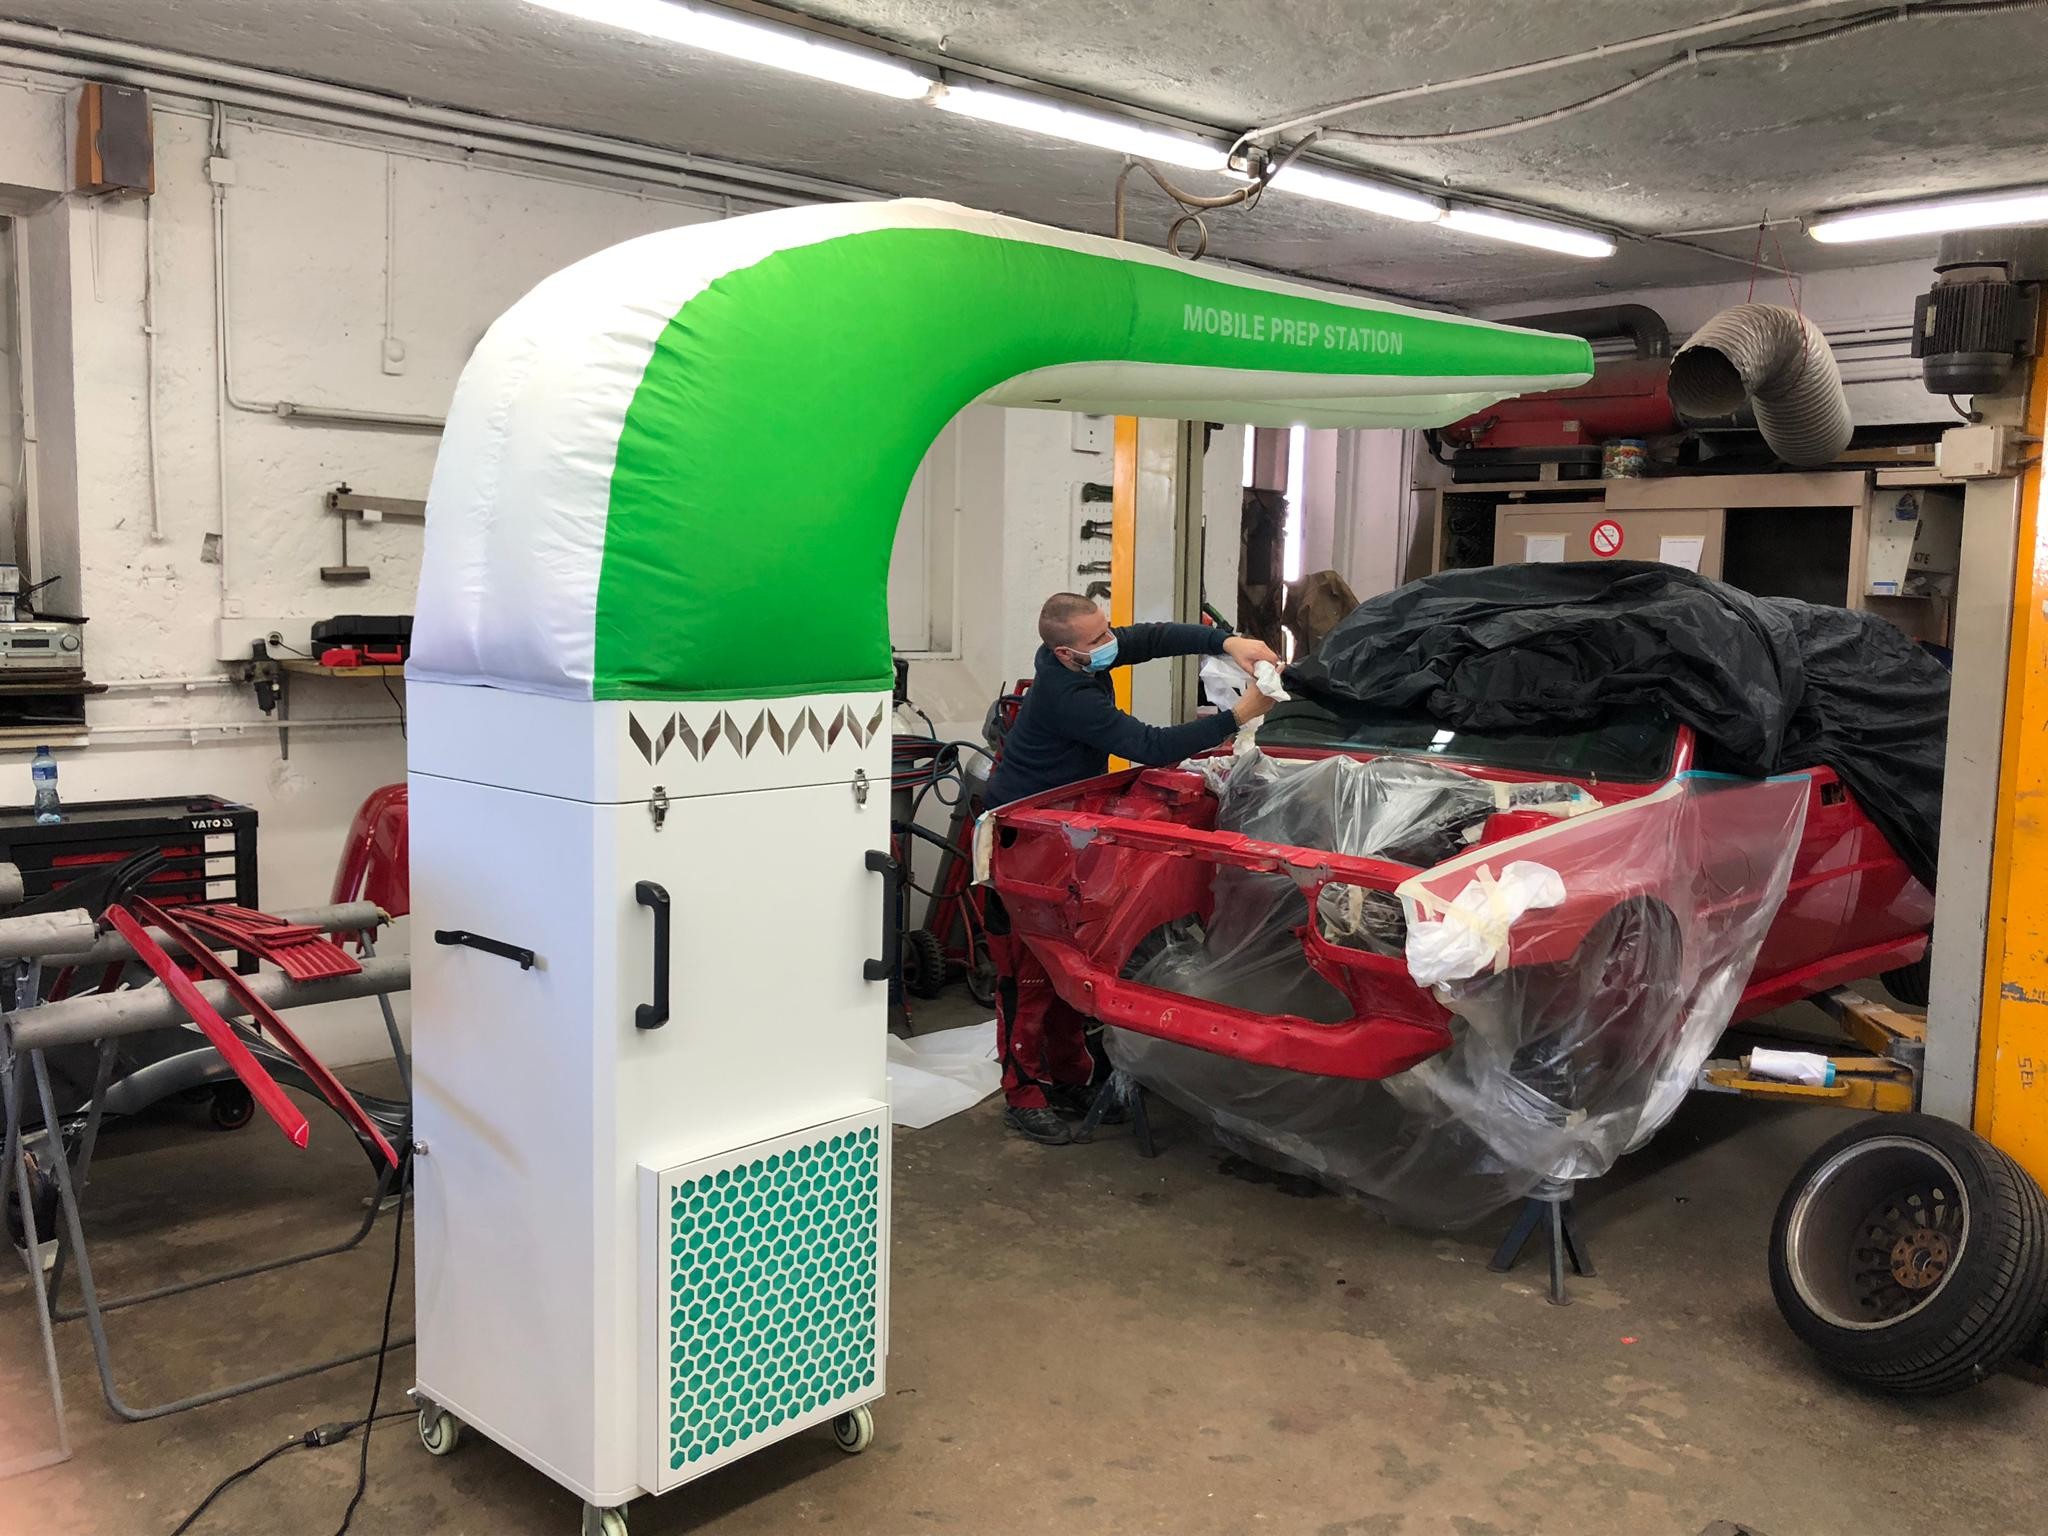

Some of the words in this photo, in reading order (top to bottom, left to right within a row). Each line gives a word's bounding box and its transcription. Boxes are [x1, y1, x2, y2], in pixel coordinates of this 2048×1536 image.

[1183, 304, 1265, 341] MOBILE
[1270, 317, 1320, 347] PREP
[1323, 324, 1403, 355] STATION
[191, 819, 221, 829] YATO
